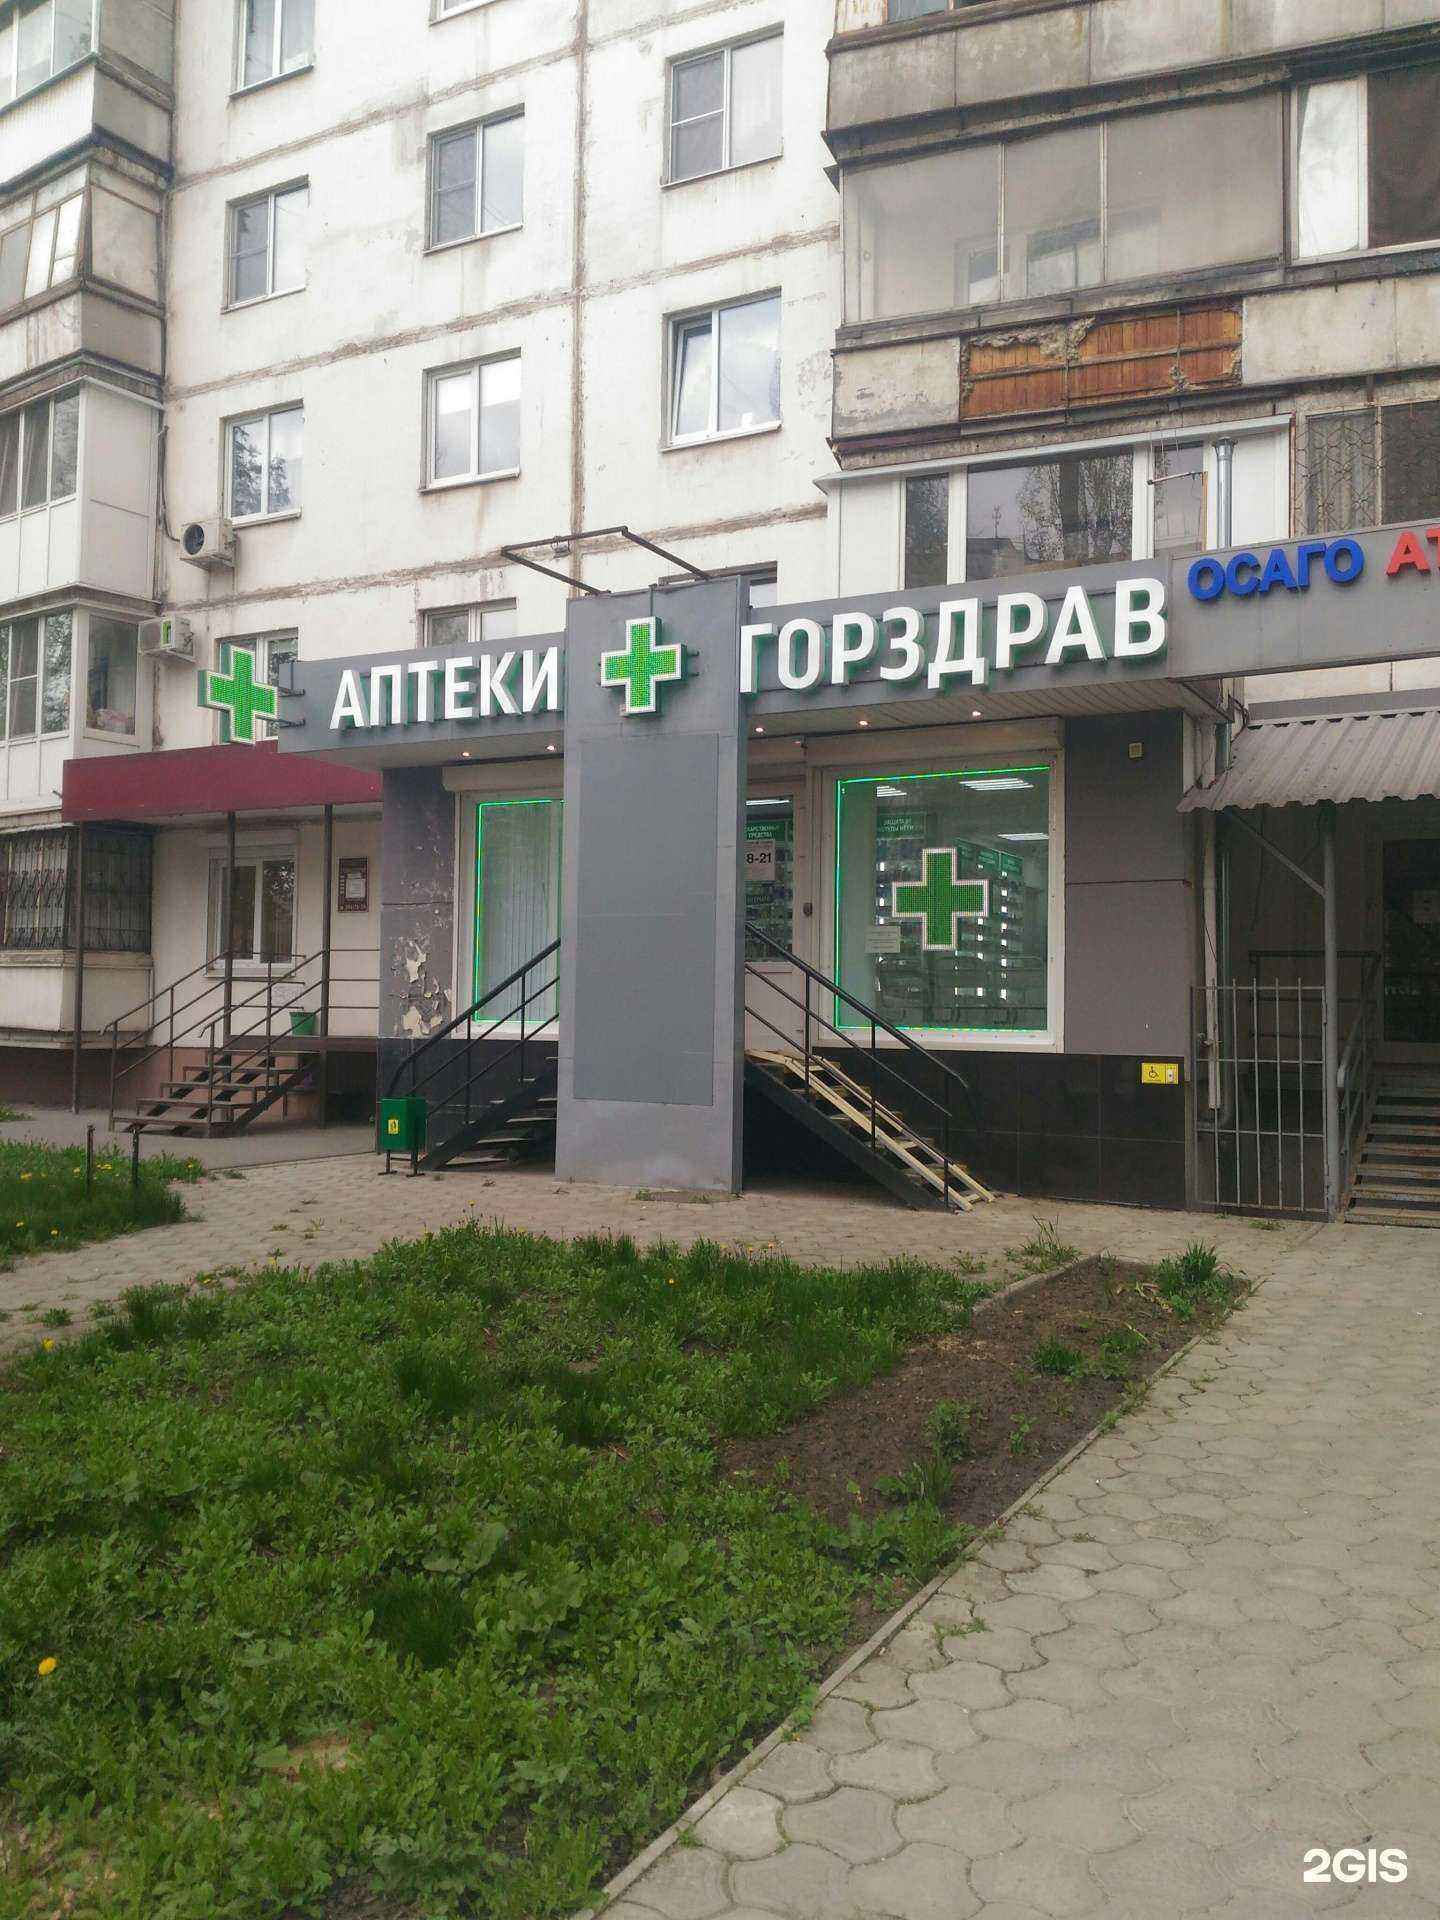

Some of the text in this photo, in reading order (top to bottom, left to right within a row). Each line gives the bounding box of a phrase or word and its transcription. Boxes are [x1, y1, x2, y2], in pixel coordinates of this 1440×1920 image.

[1187, 538, 1366, 601] ОСАГО
[329, 578, 1169, 730] АПТЕКИ ГОРЗДРАВ
